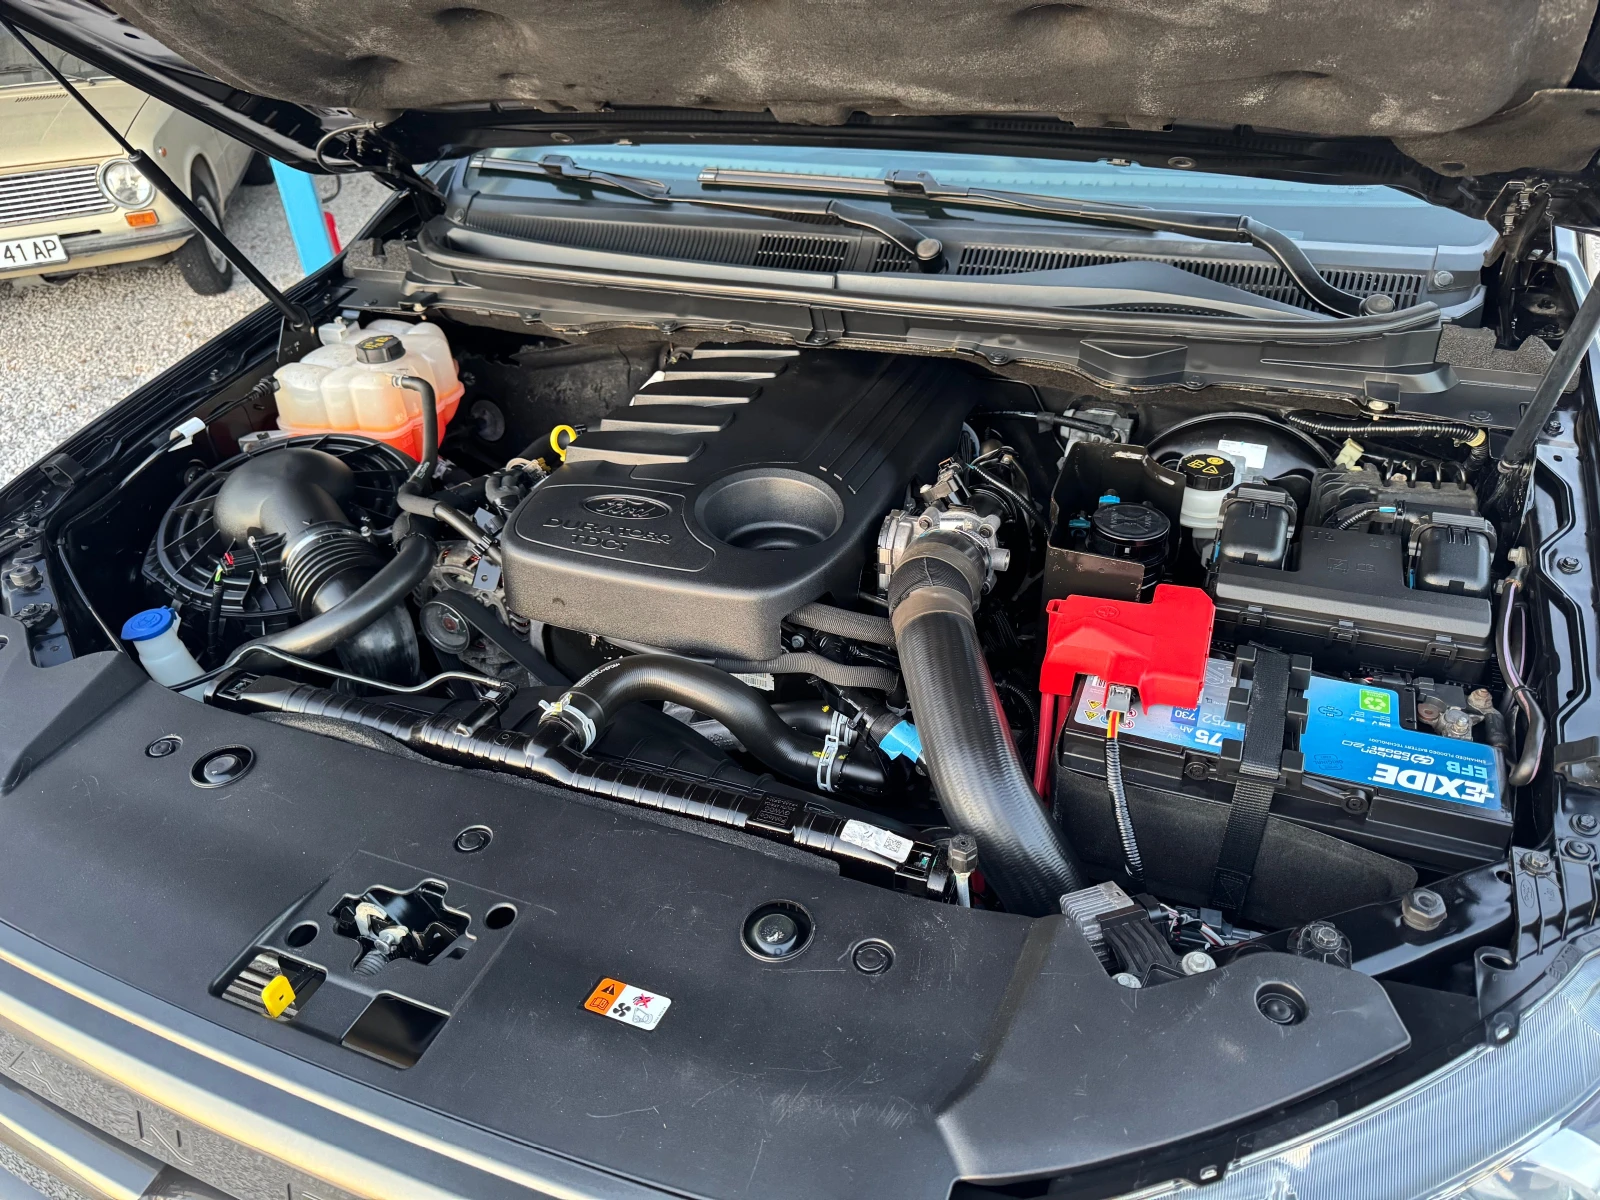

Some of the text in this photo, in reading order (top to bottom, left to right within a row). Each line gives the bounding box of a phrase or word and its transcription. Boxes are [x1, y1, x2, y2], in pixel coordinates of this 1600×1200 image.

[4, 239, 57, 263] 41 AP
[542, 518, 673, 544] DURATORQ
[1174, 709, 1196, 721] 730
[1179, 724, 1223, 747] 75 Ah
[1368, 737, 1404, 748] TECHNOLOGY
[1403, 744, 1428, 753] BATTERY
[1455, 754, 1486, 764] ENHANCED
[1446, 760, 1488, 780] EFB
[1372, 762, 1495, 804] EXIDE
